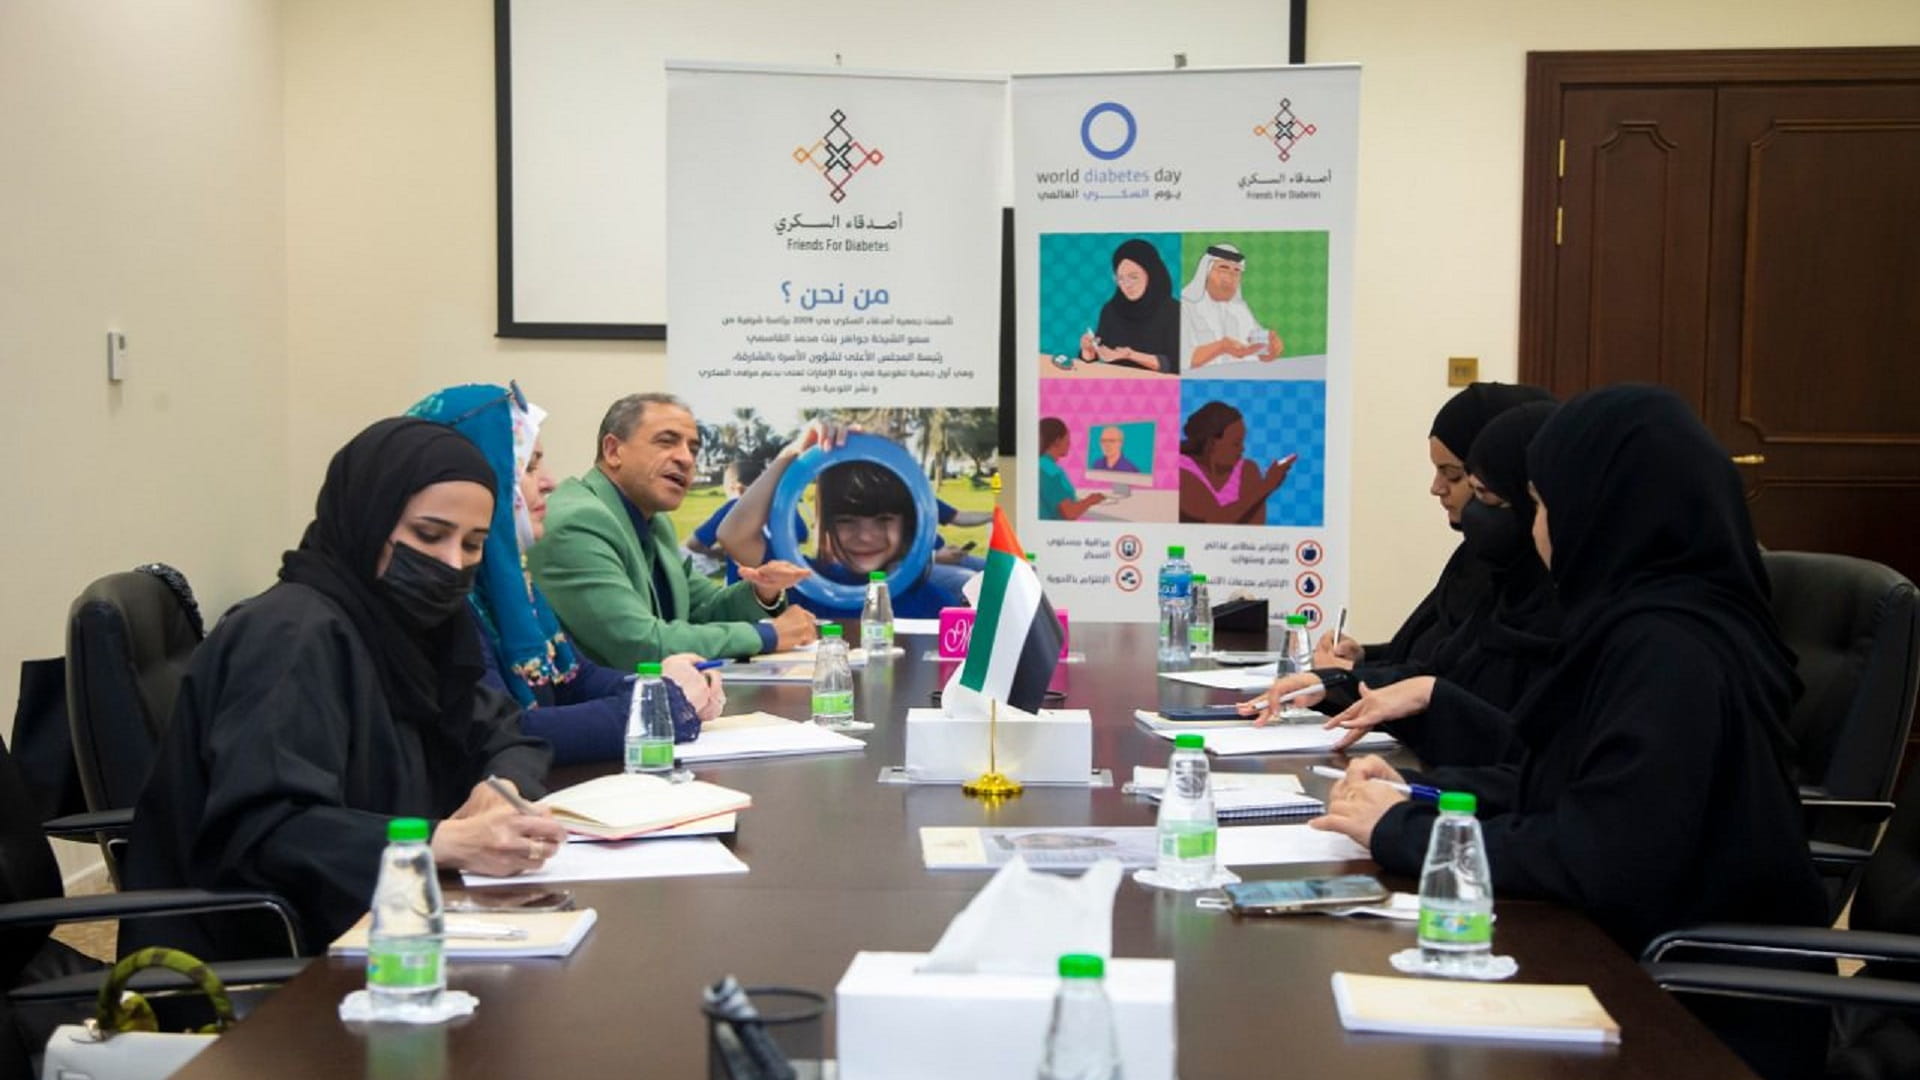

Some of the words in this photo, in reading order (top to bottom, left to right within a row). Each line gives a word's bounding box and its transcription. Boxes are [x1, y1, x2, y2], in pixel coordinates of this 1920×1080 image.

[1037, 168, 1080, 184] world
[1083, 168, 1150, 184] diabetes
[1154, 168, 1183, 185] day
[1237, 172, 1286, 190] السكري
[1289, 168, 1333, 184] أصدقاء
[1037, 189, 1079, 202] العالمي
[1082, 188, 1150, 202] السكري
[1154, 189, 1182, 202] يوم
[774, 212, 840, 235] السكري
[845, 211, 903, 231] أصدقاء
[787, 239, 824, 252] Friends
[826, 239, 842, 252] For
[845, 239, 889, 252] Diabetes
[781, 280, 792, 304] ؟
[800, 282, 844, 311] نحن
[853, 288, 890, 311] من
[746, 333, 791, 346] القاسمي
[794, 334, 818, 344] محمد
[820, 333, 837, 345] بنت
[840, 333, 869, 346] جواهر
[871, 333, 905, 345] الشيخة
[877, 352, 915, 364] المجلس
